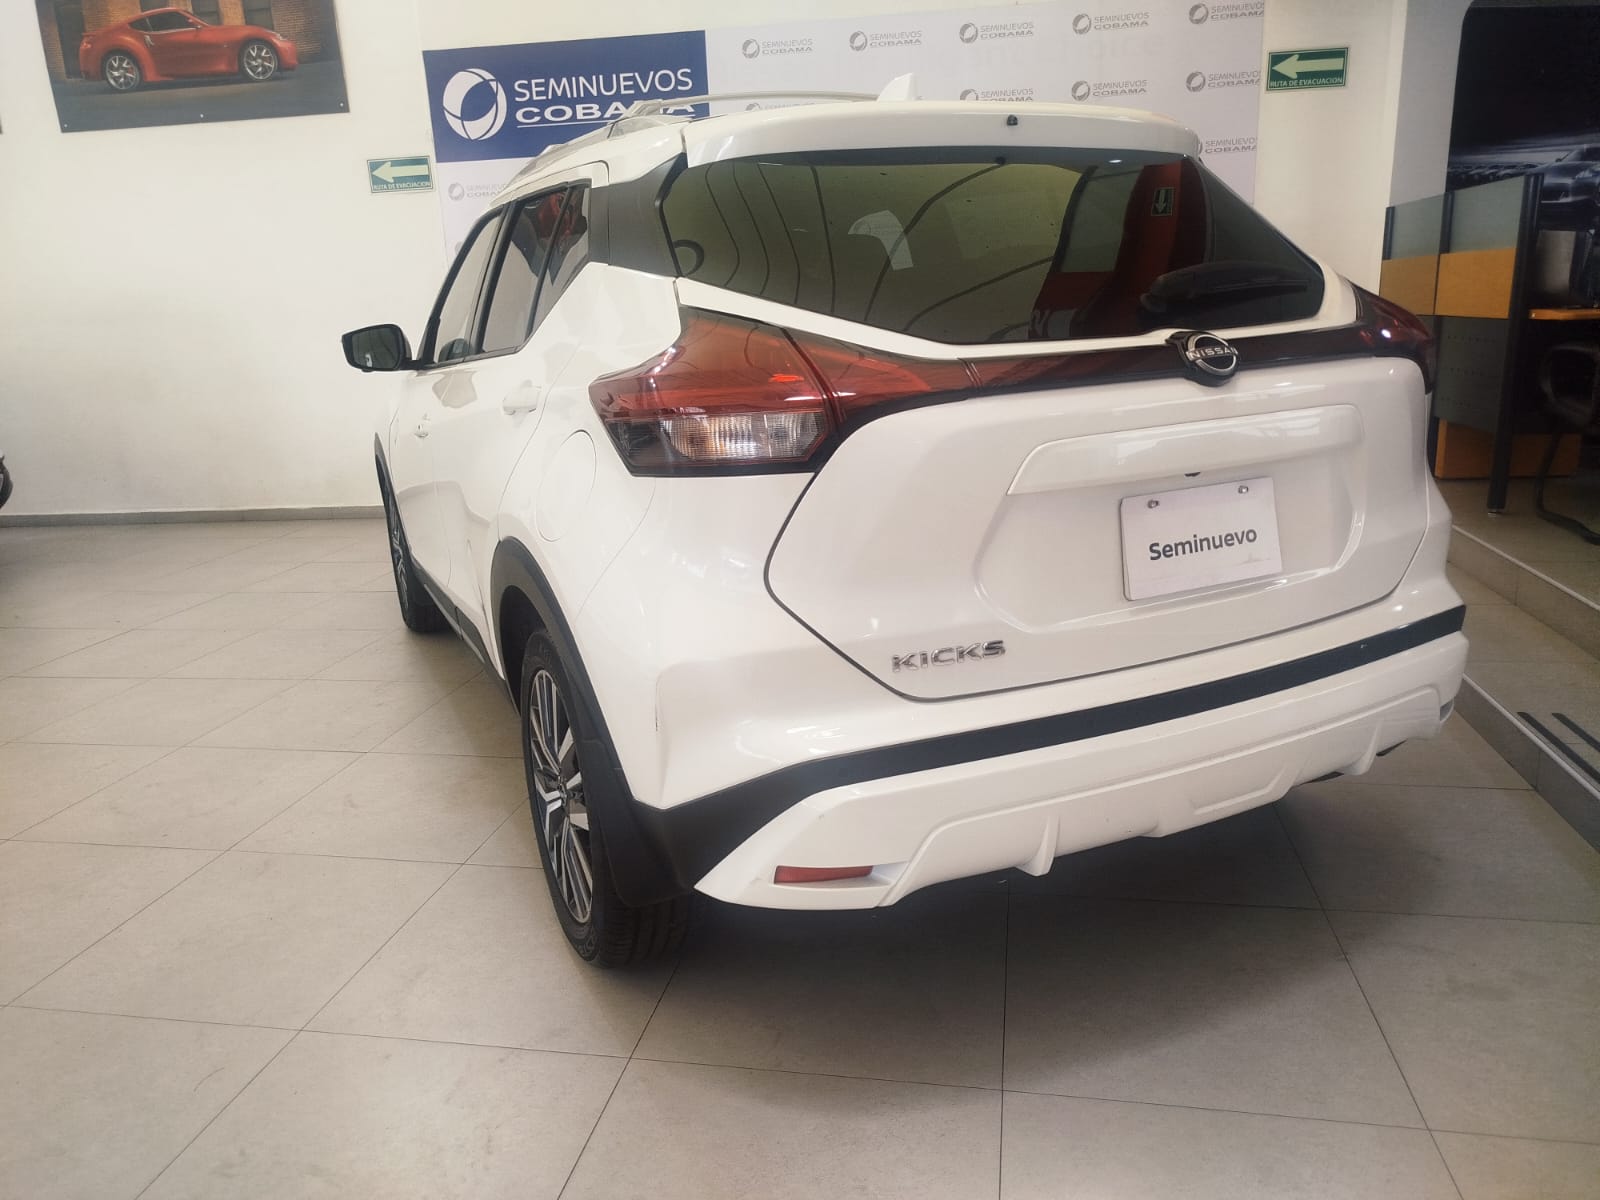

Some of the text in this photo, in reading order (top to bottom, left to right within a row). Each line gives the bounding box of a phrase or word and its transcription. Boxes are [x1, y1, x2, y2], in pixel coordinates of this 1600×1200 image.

[1094, 12, 1150, 24] SEMINUEVOS
[980, 22, 1034, 33] SEMINUEVOS
[1093, 20, 1149, 31] COBAMA
[869, 31, 922, 41] SEMINUEVOS
[980, 30, 1034, 40] COBAMA
[761, 38, 813, 49] SEMINUEVOS
[869, 39, 922, 48] COBAMA
[761, 47, 813, 55] COBAMA
[514, 68, 693, 102] SEMINUEVOS
[1093, 79, 1147, 91] SEMINUEVOS
[981, 88, 1034, 98] SEMINUEVOS
[1092, 87, 1147, 97] COBAMA
[515, 100, 694, 123] COBAA
[1205, 137, 1257, 146] SEMINUEVO
[1189, 346, 1239, 359] NISSAN
[1148, 528, 1258, 561] Seminuevo
[892, 639, 1006, 673] KICKS
